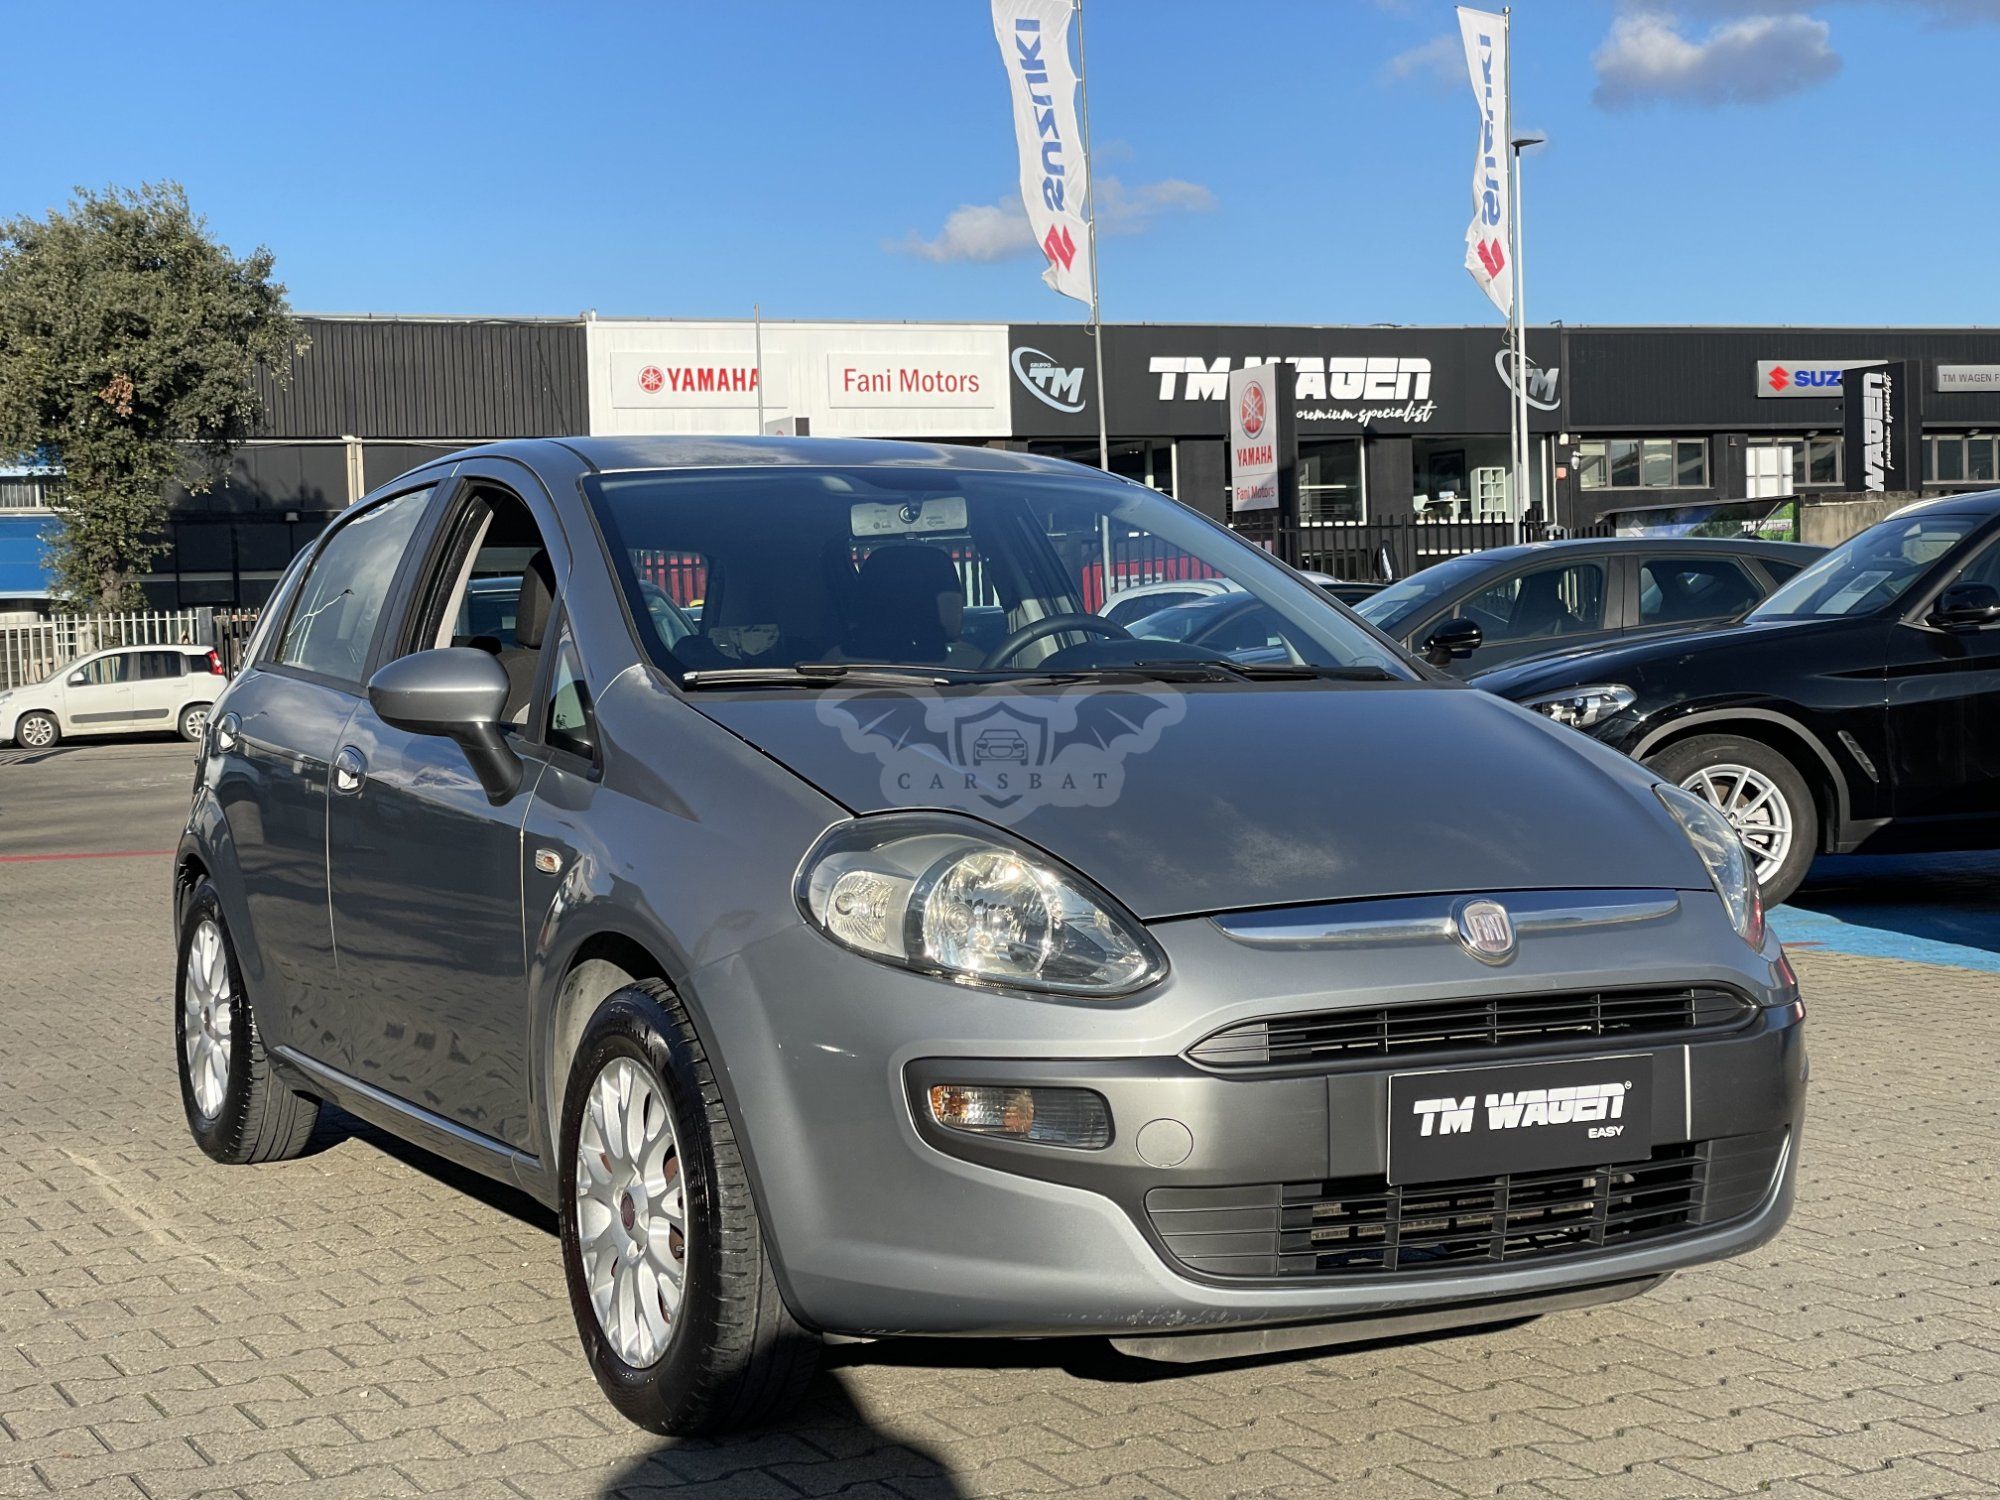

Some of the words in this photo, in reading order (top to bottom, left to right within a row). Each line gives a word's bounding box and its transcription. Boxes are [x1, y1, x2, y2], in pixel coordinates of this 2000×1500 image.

[666, 368, 759, 392] YAMAHA
[844, 368, 891, 392] Fani
[900, 368, 980, 393] Motors
[1029, 367, 1085, 403] TM
[1149, 356, 1231, 401] TM
[1244, 356, 1432, 400] AGEN
[1942, 374, 1956, 382] TM
[1959, 373, 1992, 383] WAGEN
[1357, 400, 1438, 427] specialist
[1236, 445, 1273, 468] YAMAHA
[1236, 486, 1250, 501] Fani
[1251, 485, 1275, 500] Motors
[1469, 912, 1507, 942] FIAT
[1413, 1095, 1477, 1137] TM
[1484, 1082, 1626, 1130] WAGEN
[1588, 1125, 1625, 1139] EASY
